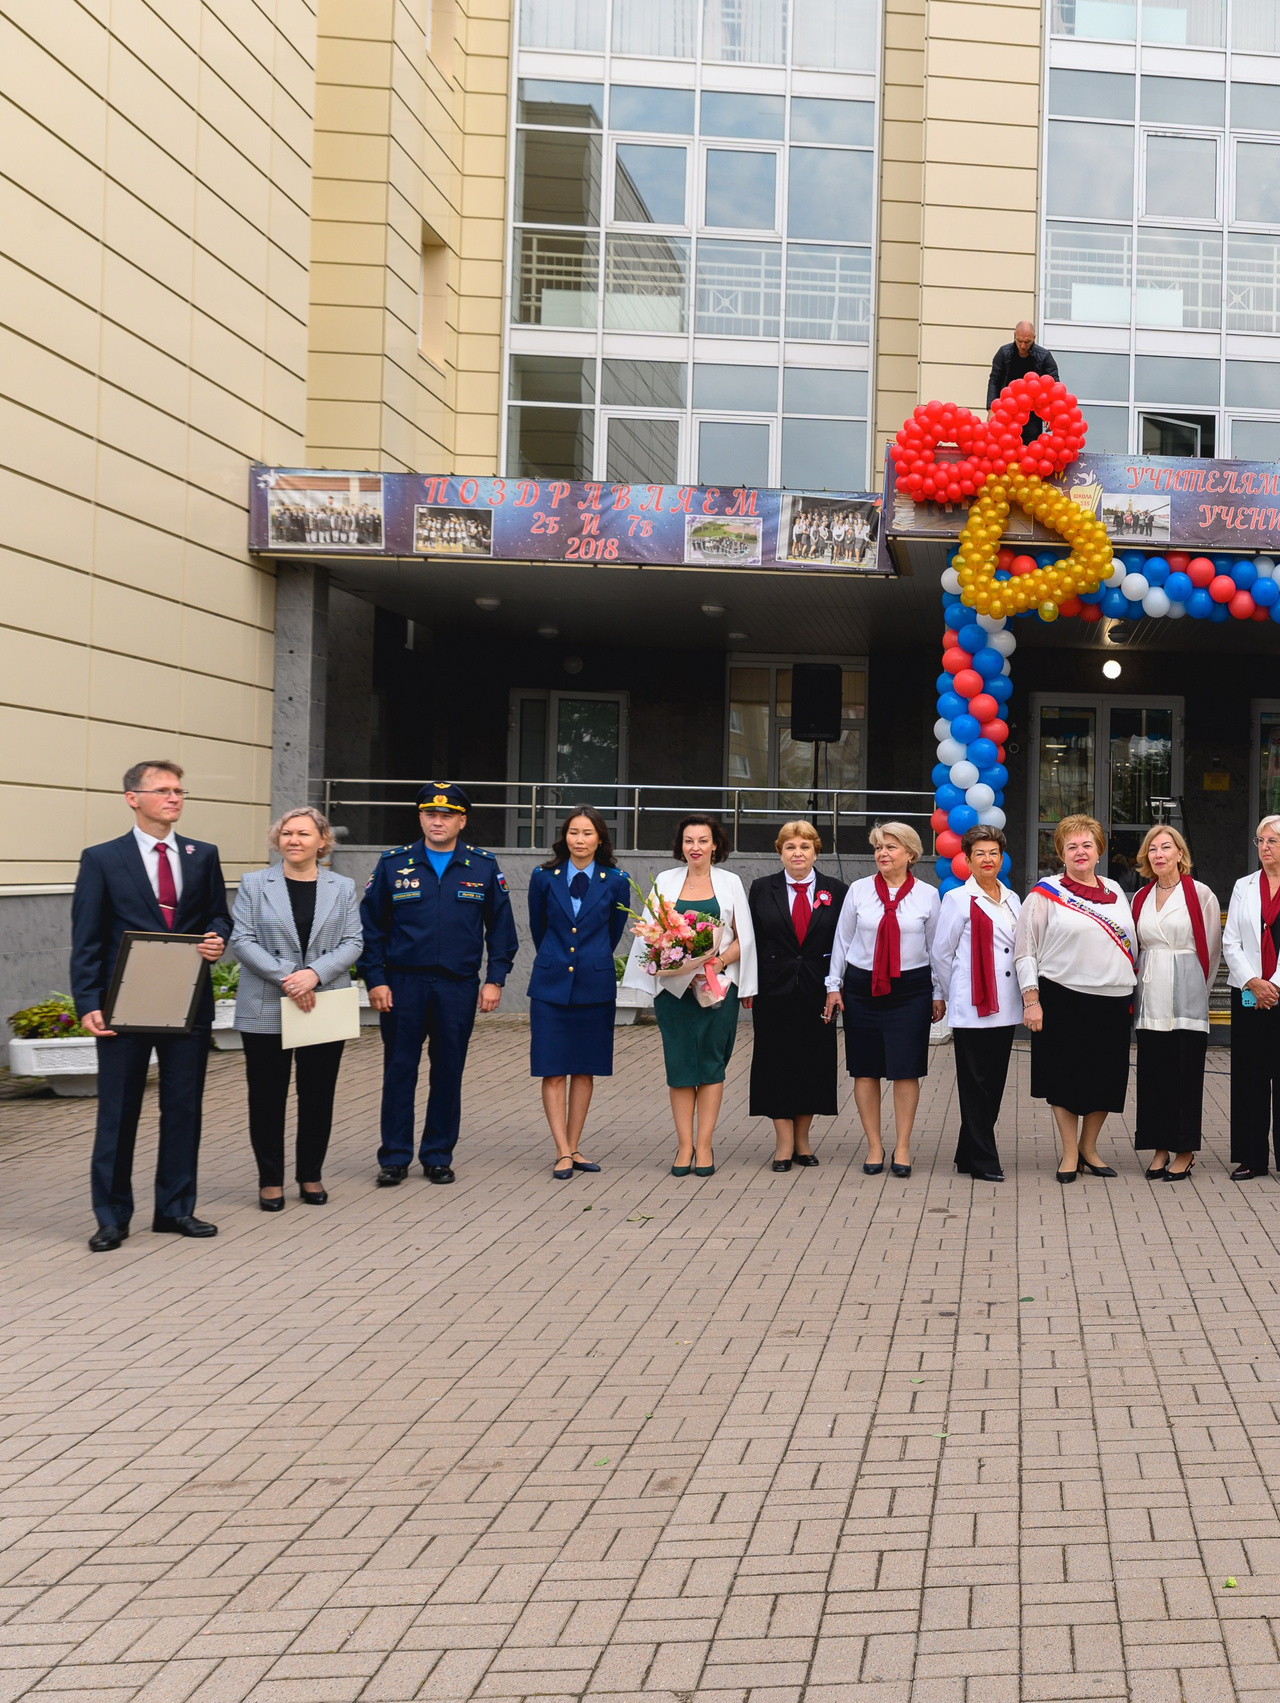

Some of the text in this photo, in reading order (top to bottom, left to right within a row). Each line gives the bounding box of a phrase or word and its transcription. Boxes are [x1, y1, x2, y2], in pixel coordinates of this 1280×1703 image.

[424, 477, 759, 516] ПОЗДРАВЛЯЕМ
[580, 512, 600, 535] И
[565, 537, 619, 559] 2018
